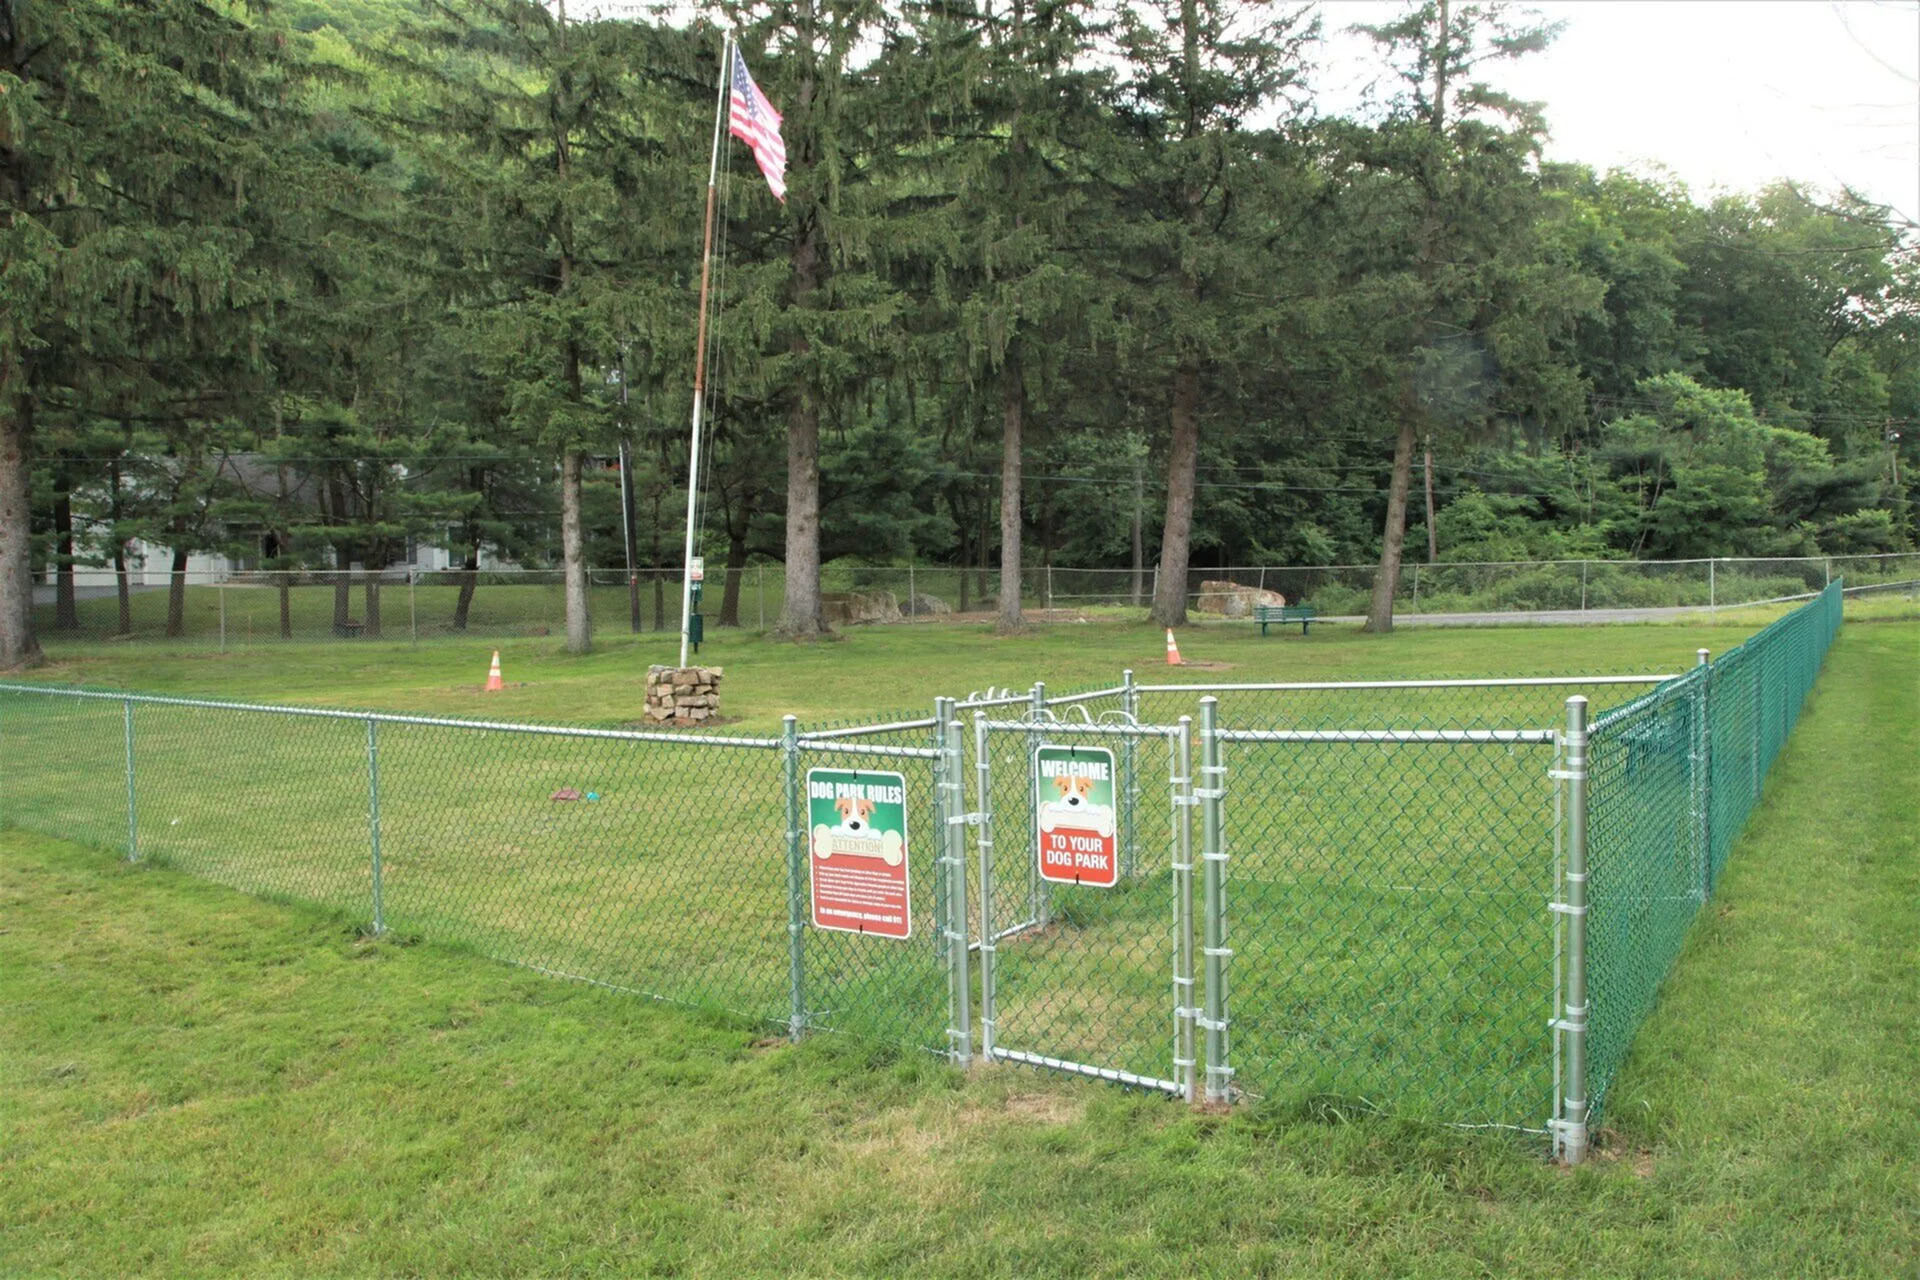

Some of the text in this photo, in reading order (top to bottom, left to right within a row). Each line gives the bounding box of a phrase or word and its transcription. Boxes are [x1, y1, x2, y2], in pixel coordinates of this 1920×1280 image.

[1040, 759, 1109, 780] WELCOME
[811, 781, 902, 804] DOG PARK RULES
[1050, 835, 1103, 852] TO YOUR
[1047, 850, 1109, 870] DOG PARK
